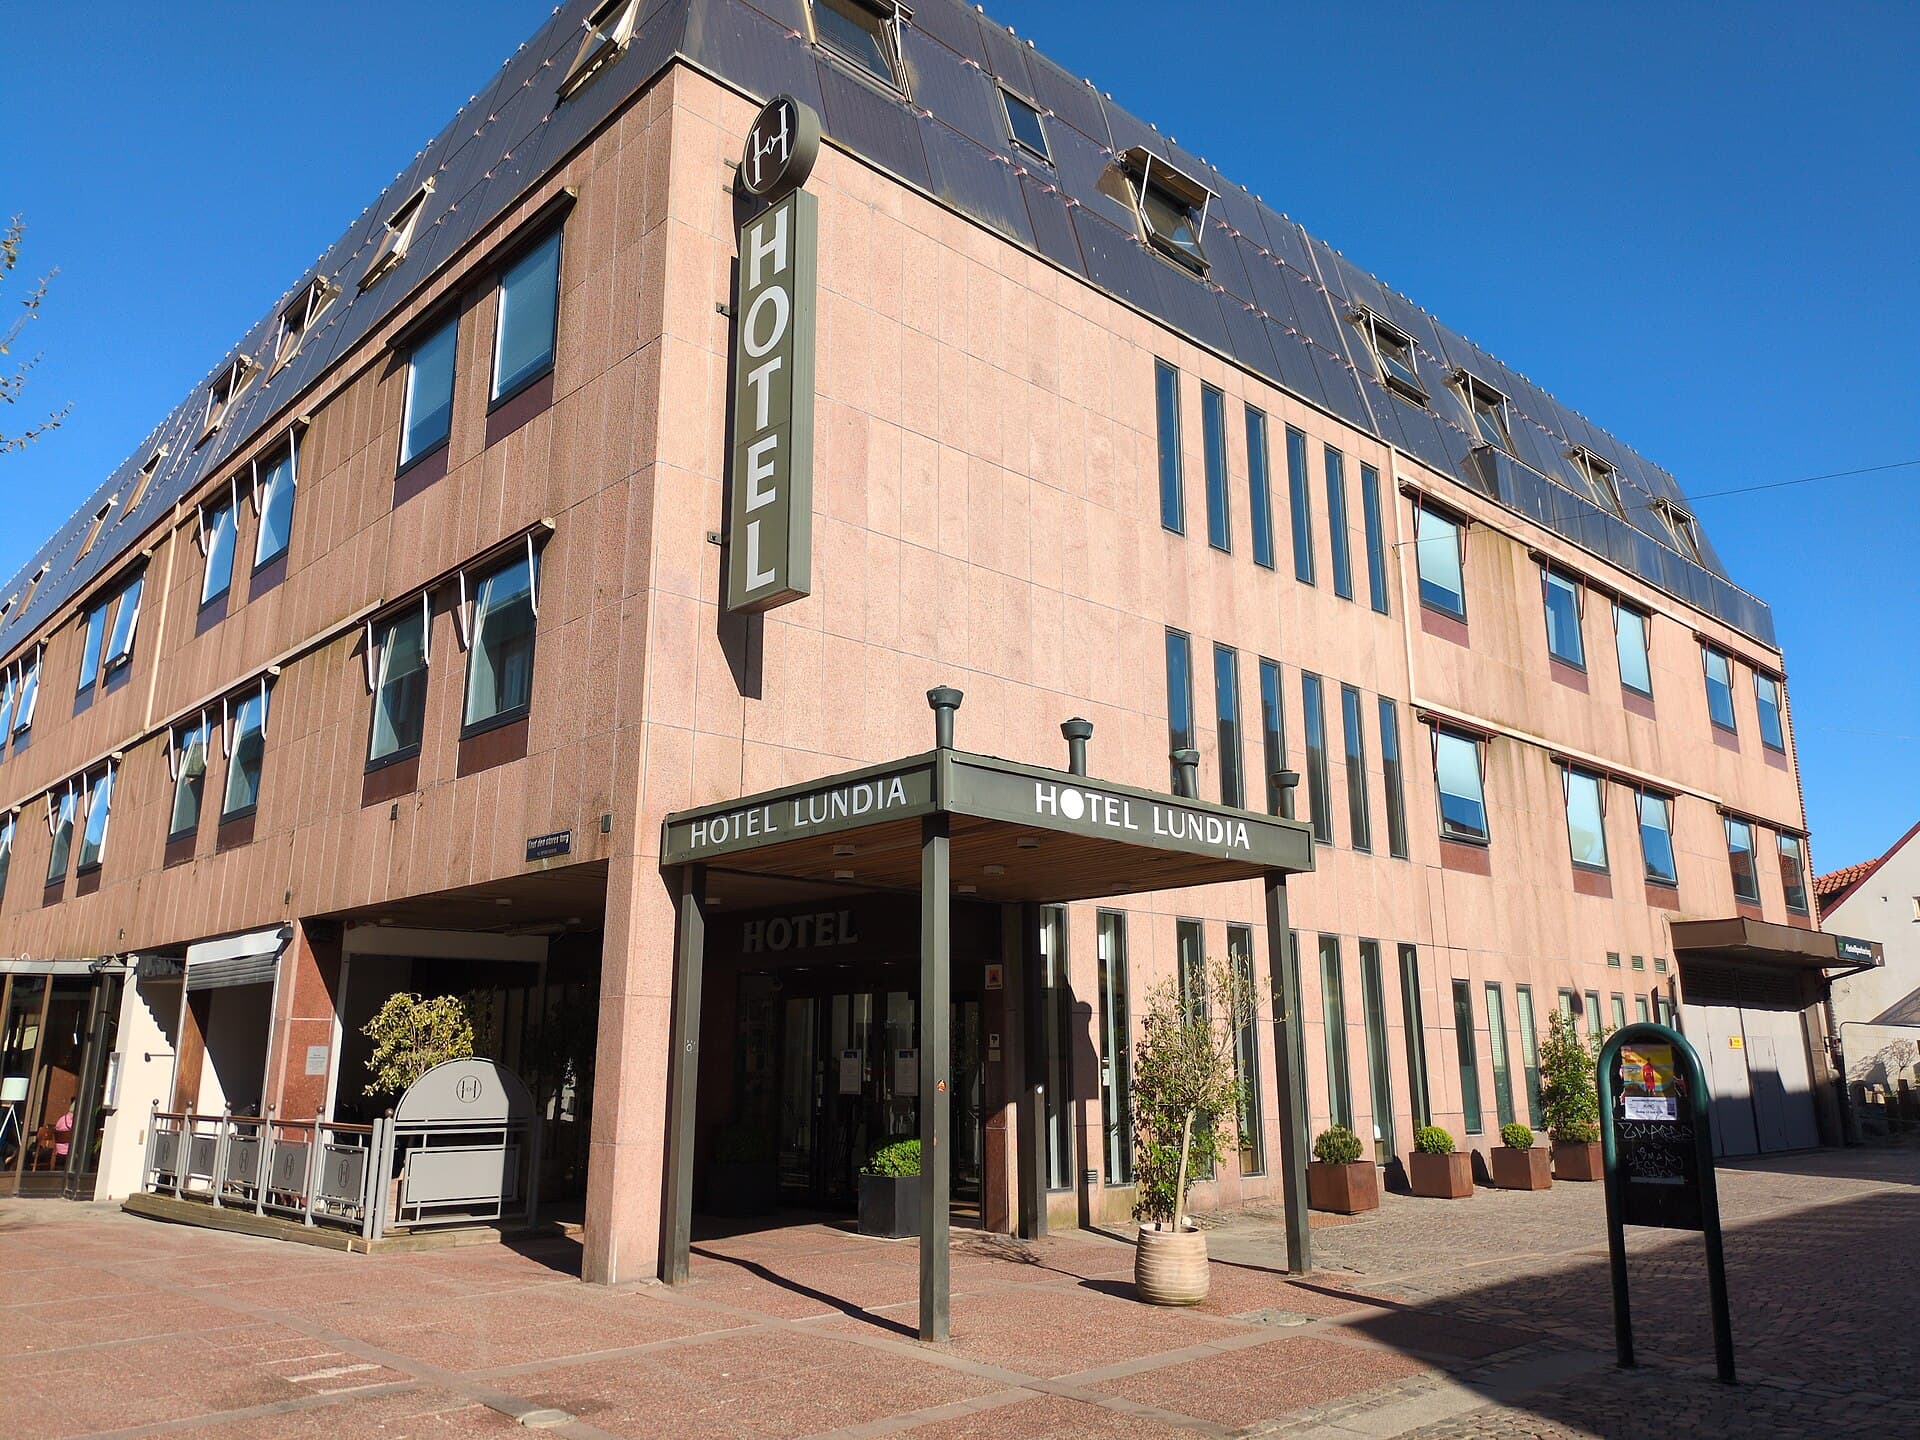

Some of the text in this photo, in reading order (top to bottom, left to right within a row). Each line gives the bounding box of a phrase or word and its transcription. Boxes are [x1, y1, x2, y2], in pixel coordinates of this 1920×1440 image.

[744, 205, 790, 593] HOTEL
[690, 777, 907, 848] HOTEL LUNDIA
[1035, 783, 1250, 850] HOTEL LUNDIA
[743, 910, 858, 952] HOTEL
